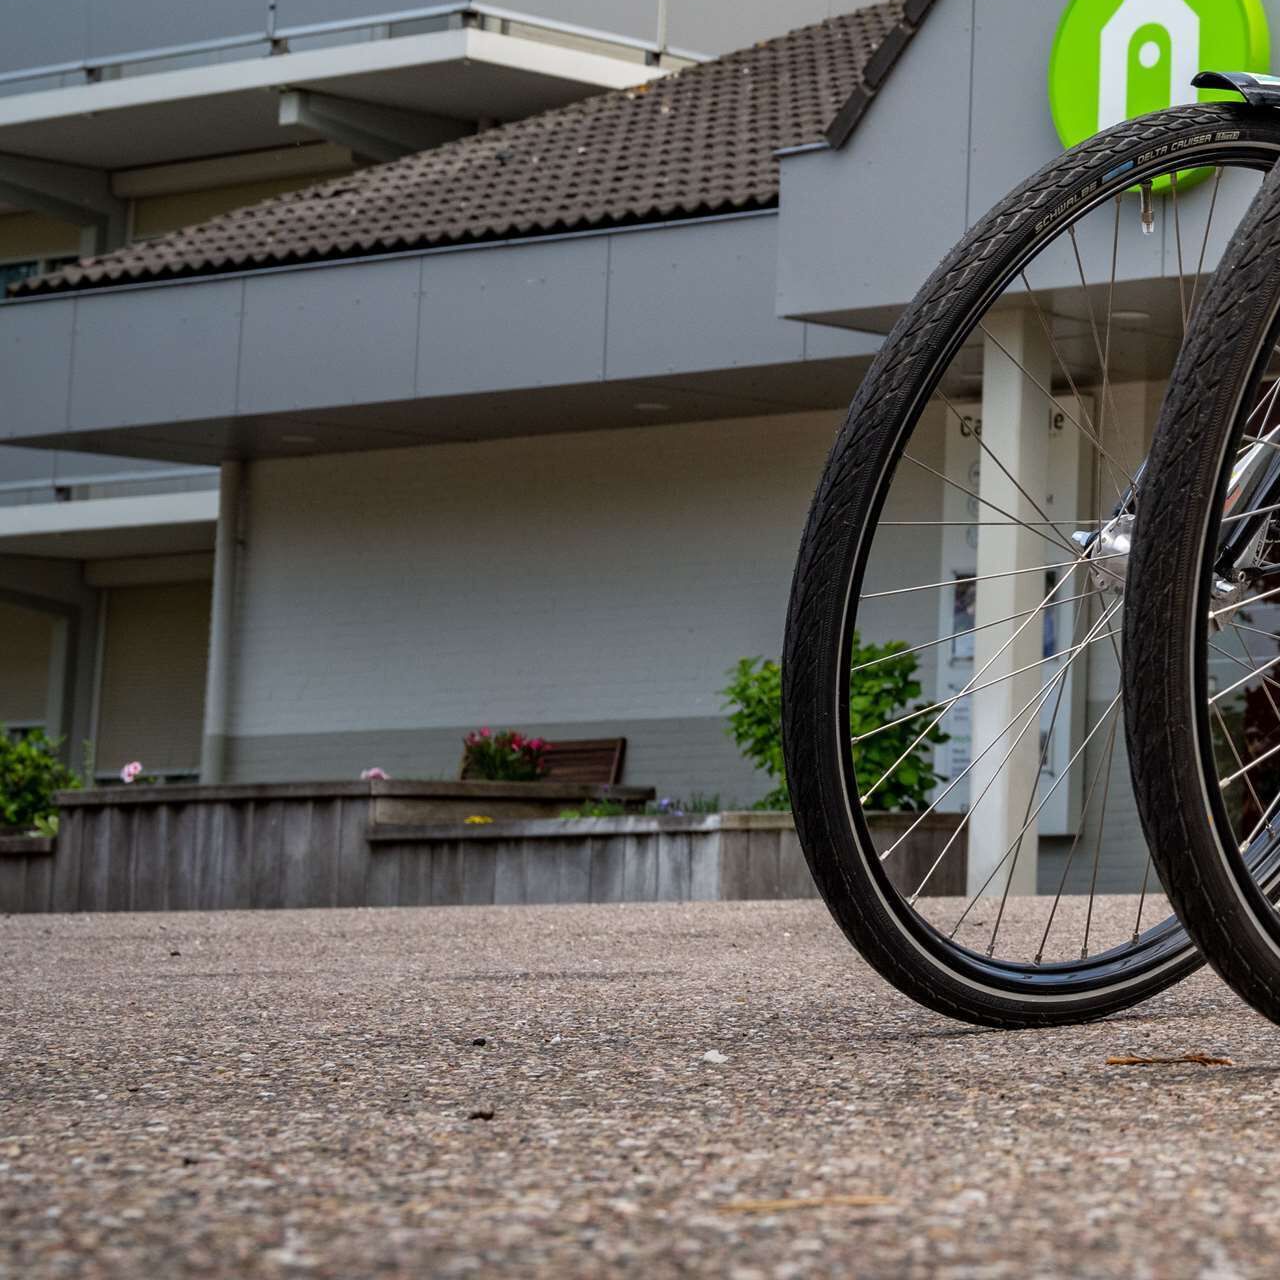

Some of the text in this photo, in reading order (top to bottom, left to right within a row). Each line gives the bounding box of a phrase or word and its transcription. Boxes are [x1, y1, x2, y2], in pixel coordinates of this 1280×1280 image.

[1034, 180, 1098, 235] SCHWALBE
[1136, 144, 1168, 166] DELTA
[1170, 132, 1212, 152] CRUISER
